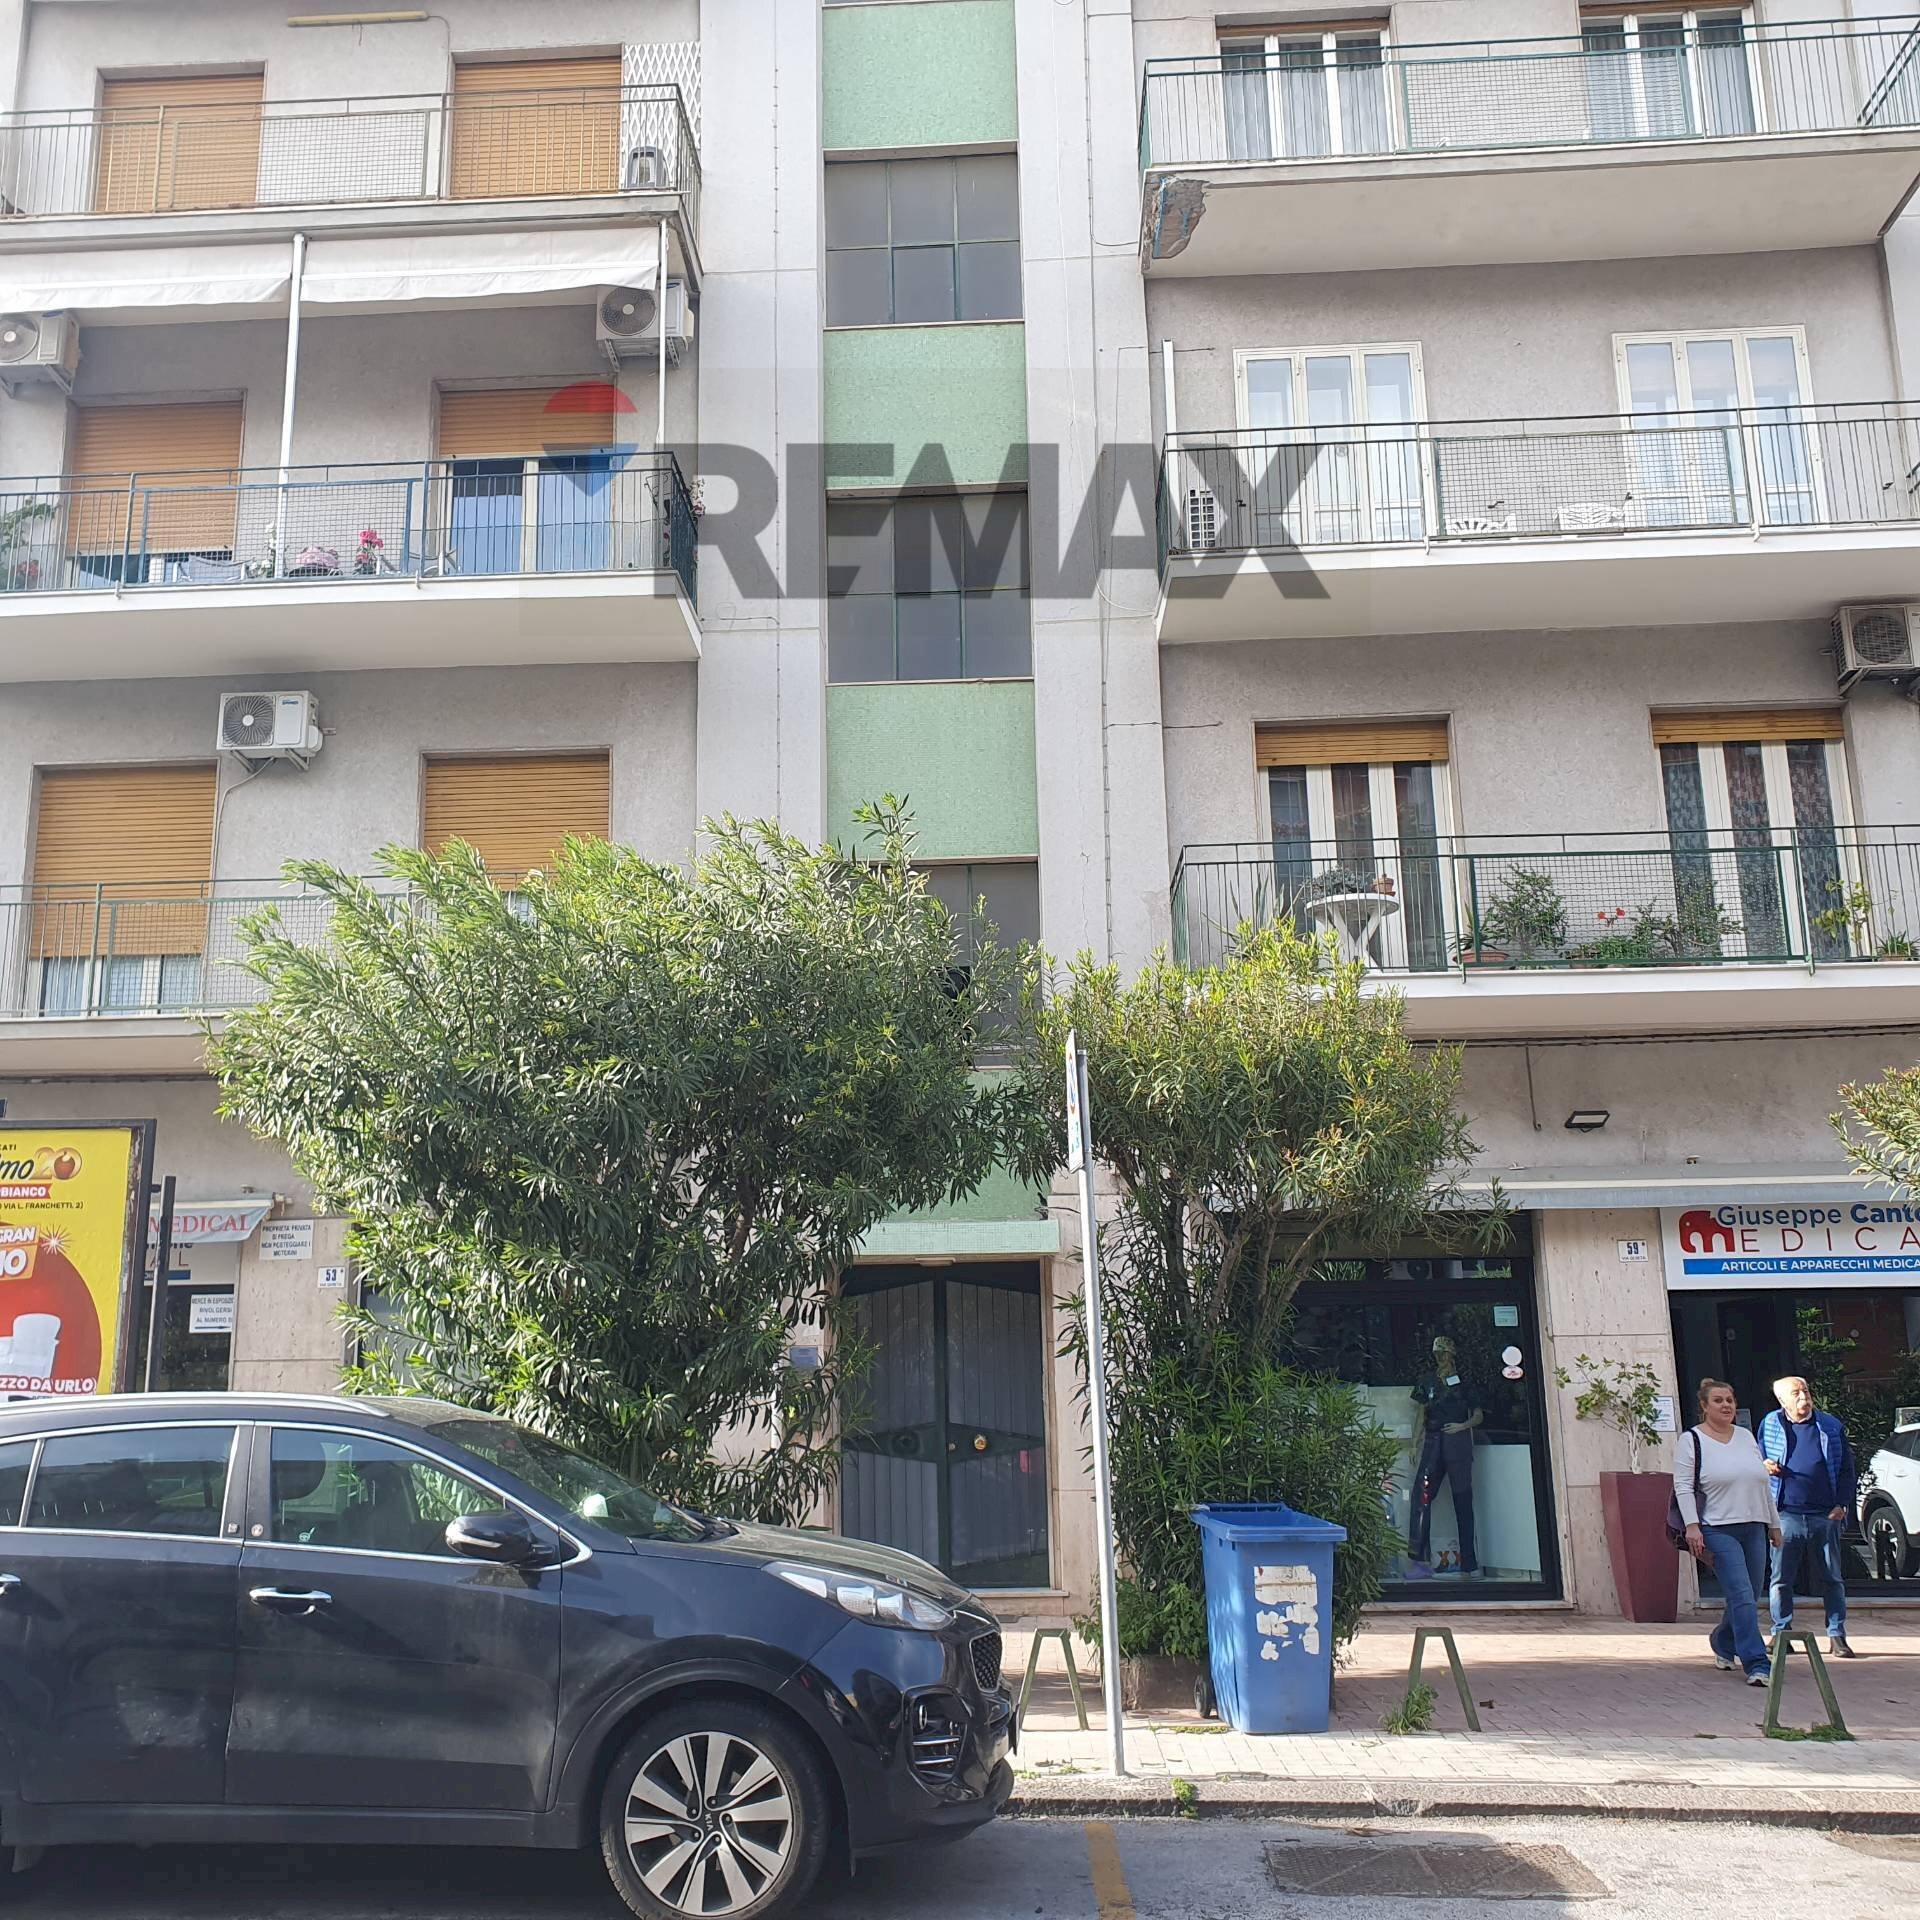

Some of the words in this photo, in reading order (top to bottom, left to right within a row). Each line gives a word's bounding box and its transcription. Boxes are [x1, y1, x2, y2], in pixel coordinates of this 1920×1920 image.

[1718, 1206, 1842, 1228] Giuseppe
[1627, 1242, 1639, 1255] 59
[1721, 1260, 1777, 1271] ARTICOLI
[1780, 1260, 1788, 1270] E
[1791, 1259, 1870, 1270] APPARECCHI
[325, 1269, 337, 1281] 53
